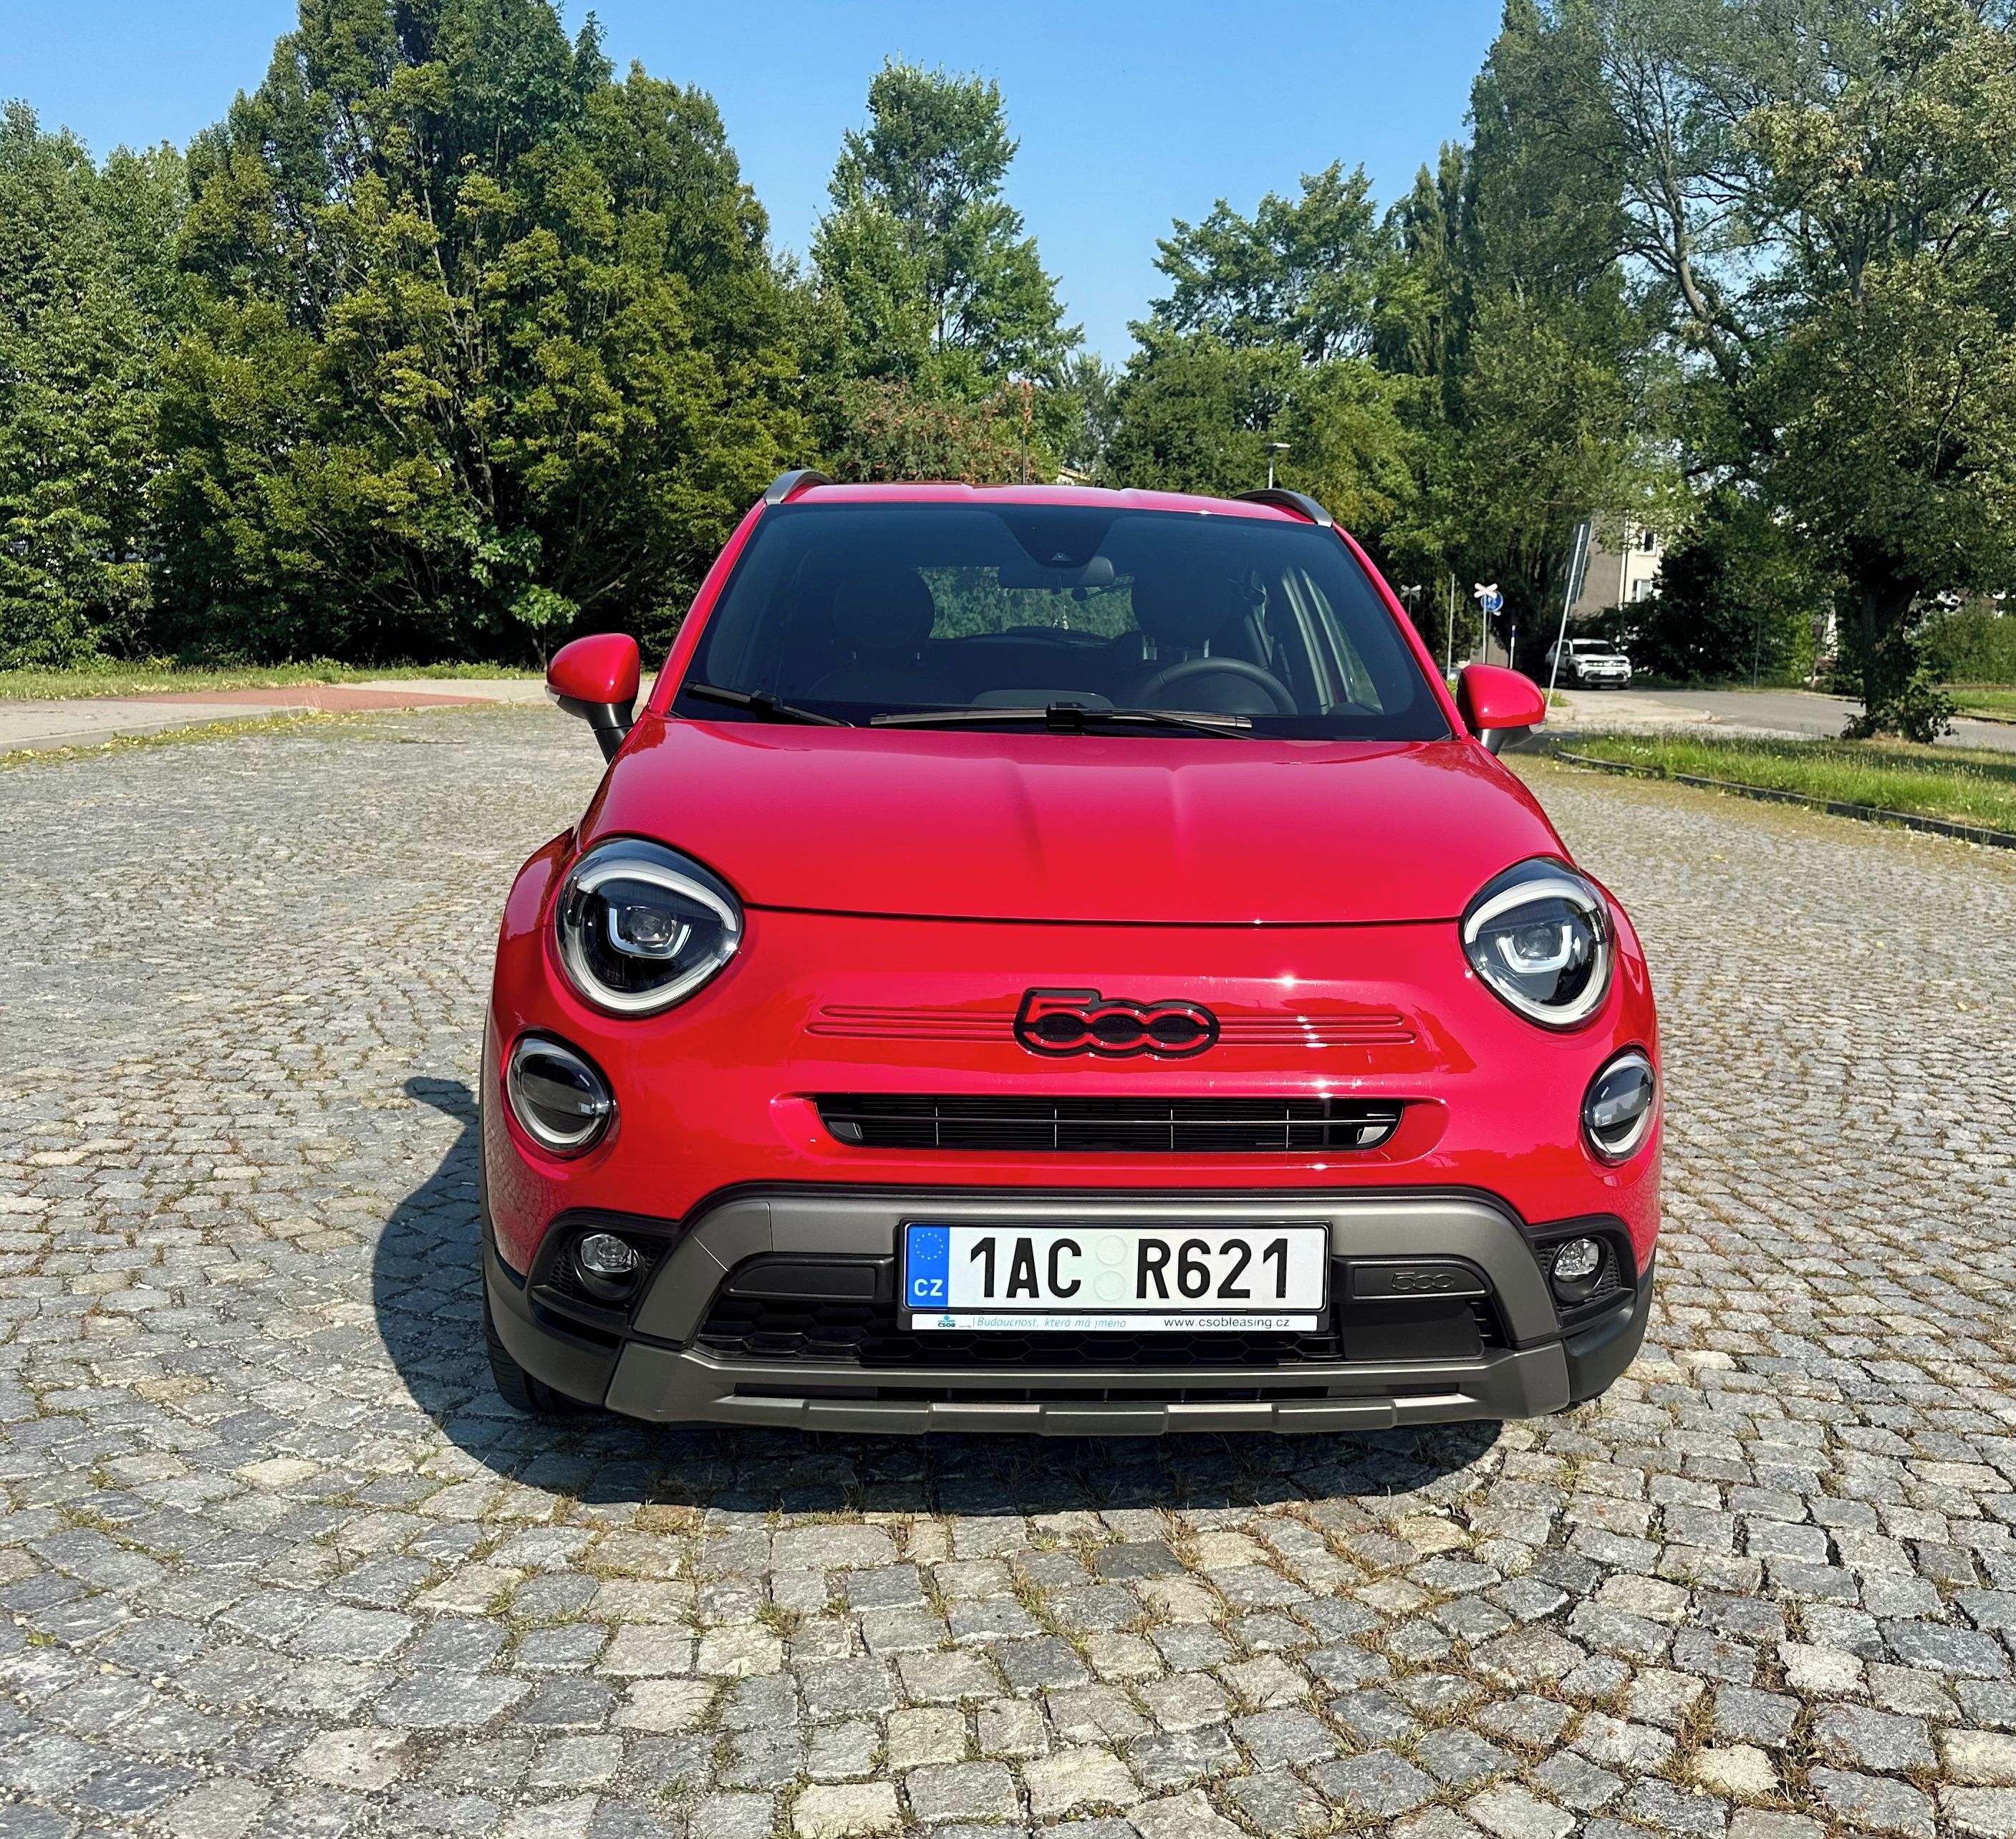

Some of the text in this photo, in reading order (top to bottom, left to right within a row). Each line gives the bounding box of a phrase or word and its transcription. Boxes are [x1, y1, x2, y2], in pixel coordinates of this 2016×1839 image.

[1013, 988, 1220, 1058] 500
[970, 1237, 1288, 1299] 1AC R621
[913, 1278, 943, 1297] CZ
[1391, 1269, 1455, 1290] 500
[977, 1316, 1039, 1328] Budoucnost,
[1044, 1317, 1071, 1328] která
[1075, 1317, 1091, 1328] má
[1164, 1316, 1290, 1329] www.csobleasing.cz
